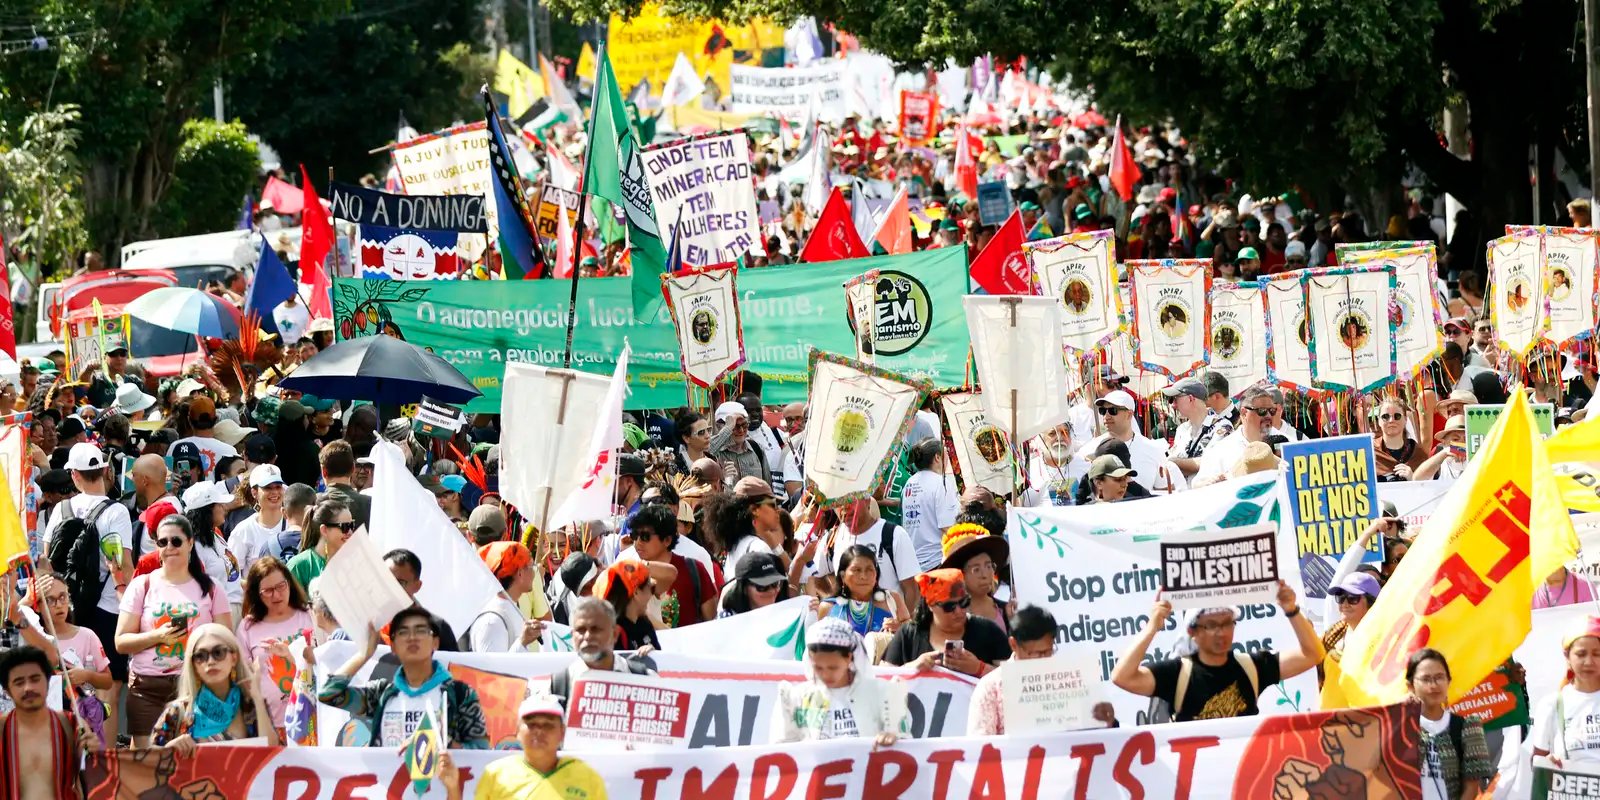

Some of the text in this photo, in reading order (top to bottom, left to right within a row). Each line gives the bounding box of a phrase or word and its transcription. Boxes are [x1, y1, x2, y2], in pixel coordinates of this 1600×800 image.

[648, 139, 734, 175] ONDE TEM
[332, 188, 490, 230] NO A DOMINGA
[686, 191, 716, 214] TEM
[686, 244, 709, 266] EM
[1547, 252, 1570, 261] APIRI
[1062, 263, 1086, 275] TAPIRI
[1338, 297, 1364, 308] TAPIRI
[1213, 310, 1238, 321] TAPIRI
[845, 395, 875, 409] TAPIRI
[1293, 448, 1368, 489] PAREM
[1298, 482, 1371, 523] DE NOS
[1166, 537, 1271, 561] END THE GENOCIDE ON
[1165, 552, 1275, 588] PALESTINE
[1046, 563, 1163, 603] Stop crim
[1224, 587, 1247, 596] CLIMATE
[1021, 670, 1082, 684] FOR PEOPLE
[583, 681, 680, 706] END IMPERIALIST
[1018, 689, 1090, 704] AGROECOLOGY
[1022, 684, 1042, 694] AND
[578, 697, 681, 722] PLUNDER, END THE
[1042, 701, 1069, 712] NOW!
[581, 713, 673, 737] CLIMATE CRISIS!
